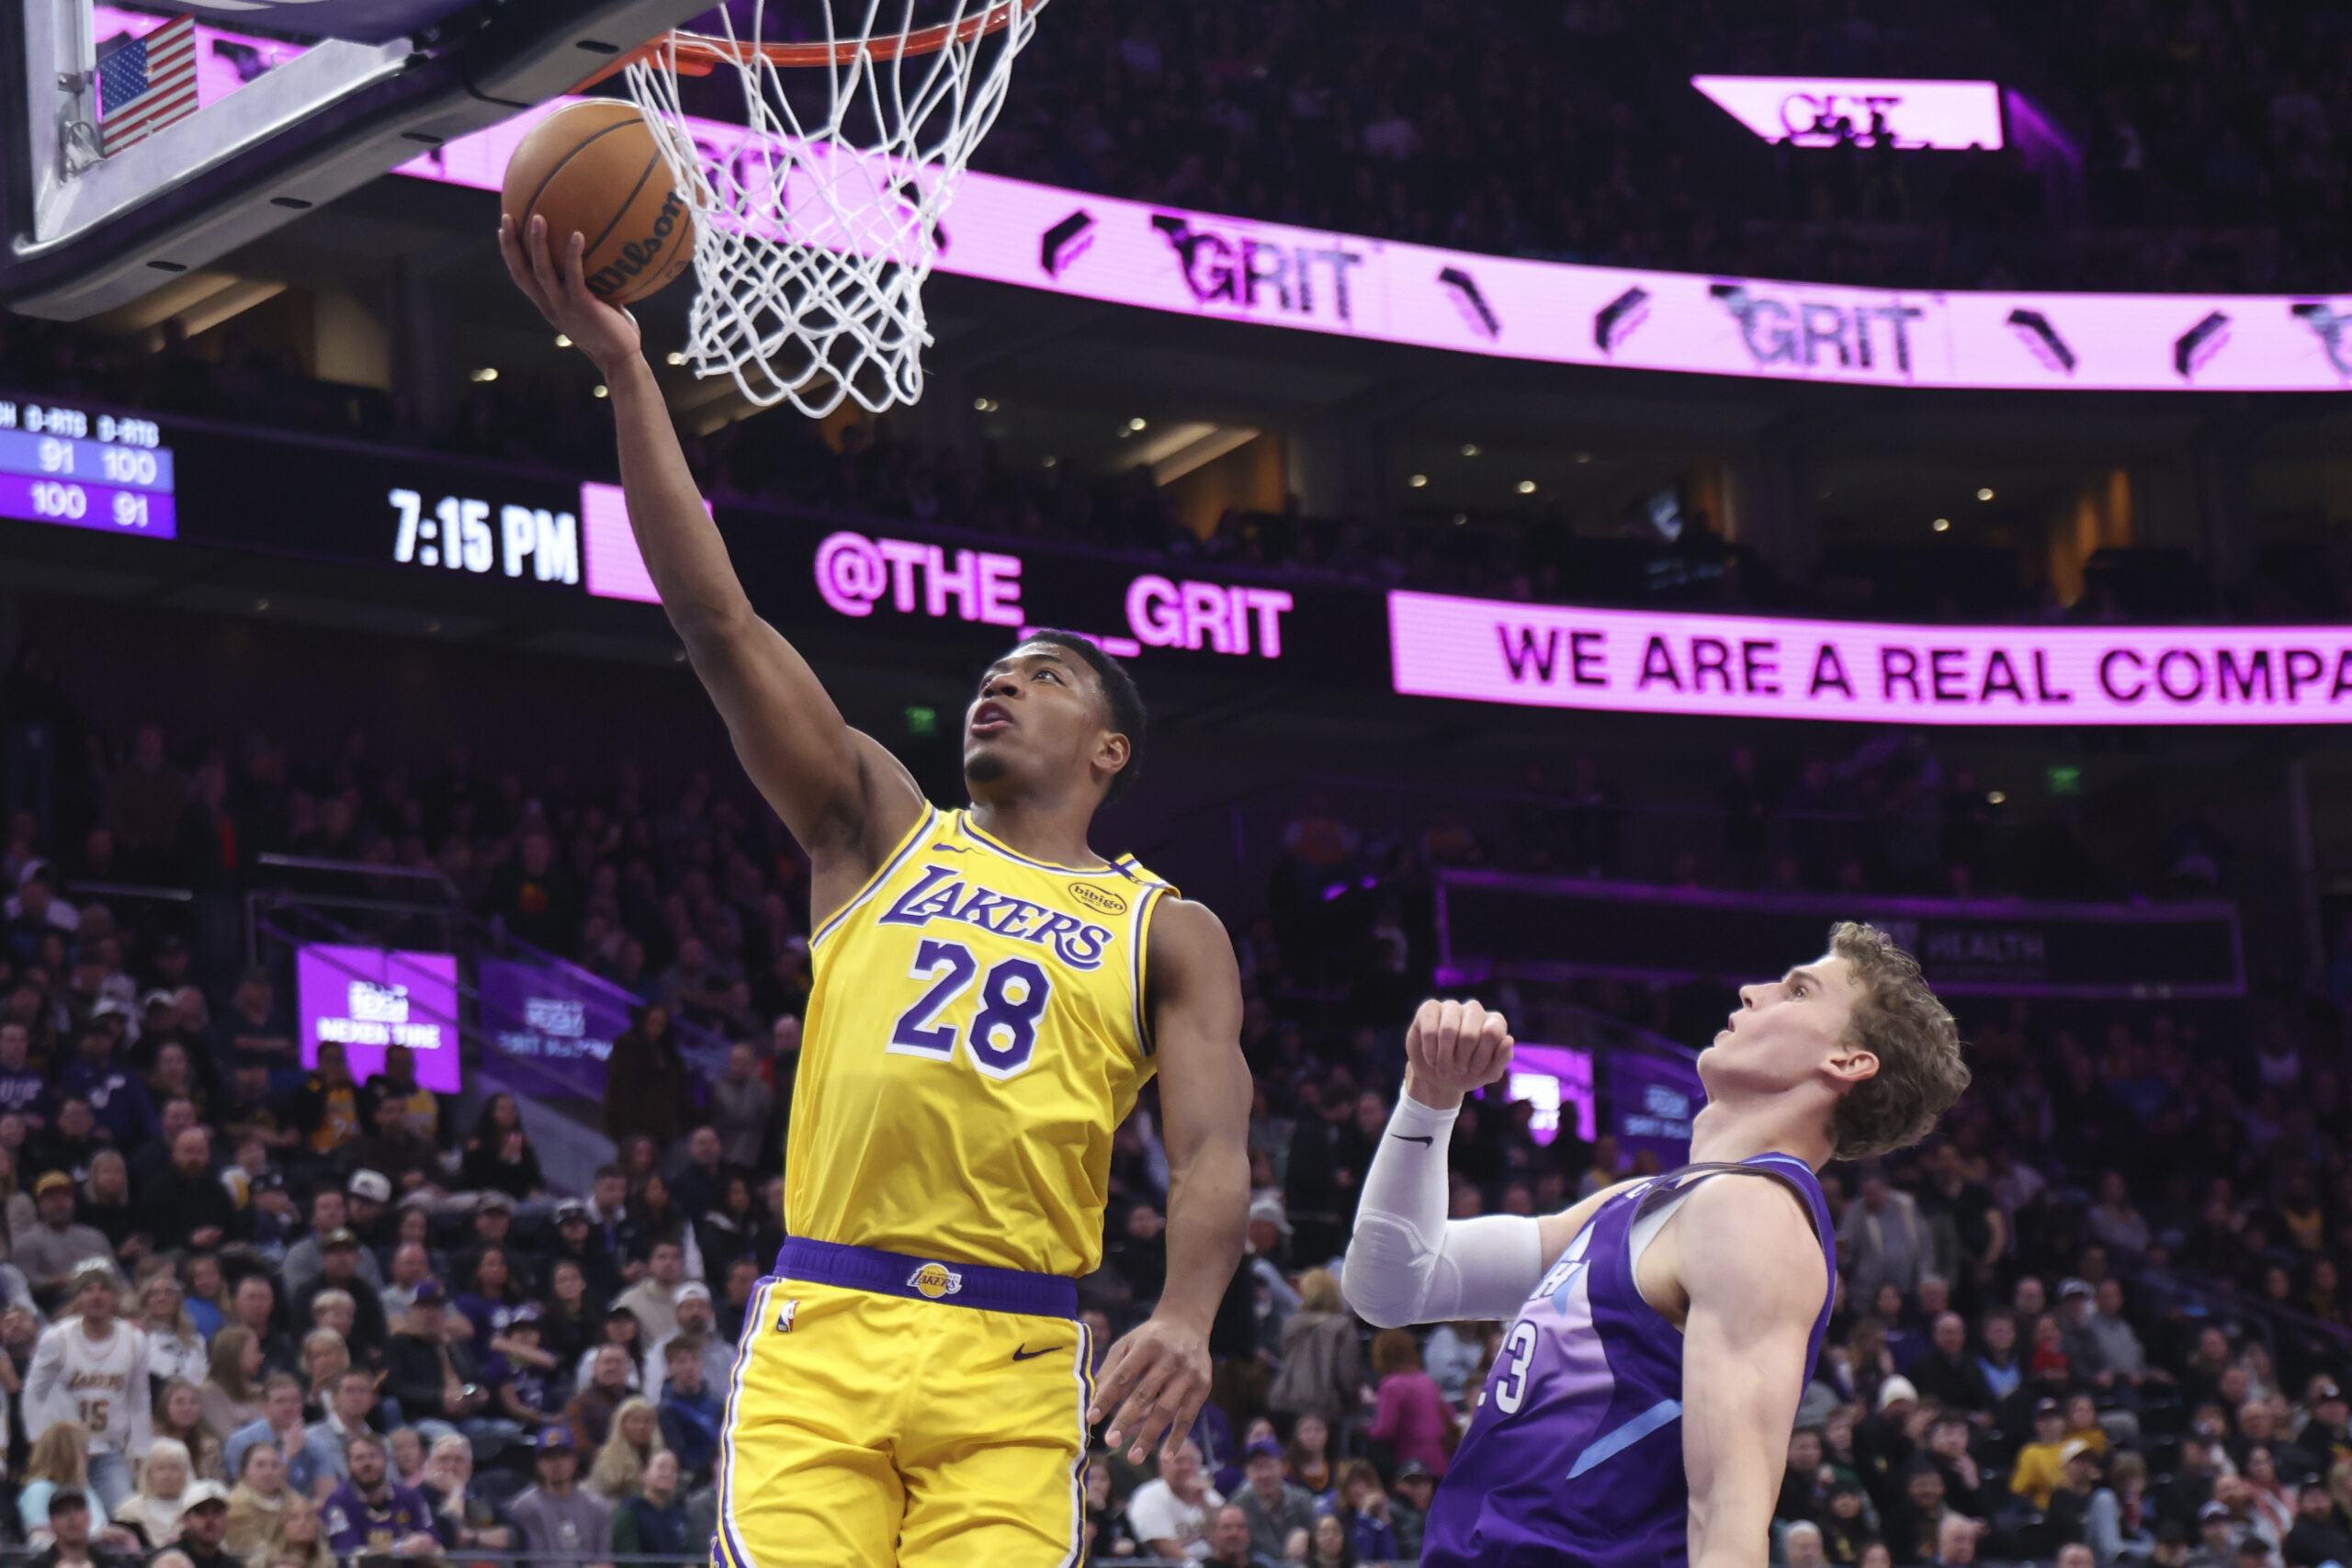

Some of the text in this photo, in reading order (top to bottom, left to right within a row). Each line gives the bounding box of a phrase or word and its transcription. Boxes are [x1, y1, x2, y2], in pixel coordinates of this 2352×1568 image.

[586, 188, 685, 296] Wilson
[39, 436, 157, 485] 91 100
[31, 480, 149, 528] 100 91
[388, 488, 579, 585] 7:15 PM
[1498, 626, 1607, 687] WE
[1638, 635, 1783, 694] ARE
[1810, 644, 1852, 698] A
[1882, 647, 2070, 703] REAL
[876, 864, 1115, 972] LAKERS
[1074, 885, 1125, 911] bibigo
[885, 935, 1055, 1081] 28
[79, 1399, 110, 1431] 15
